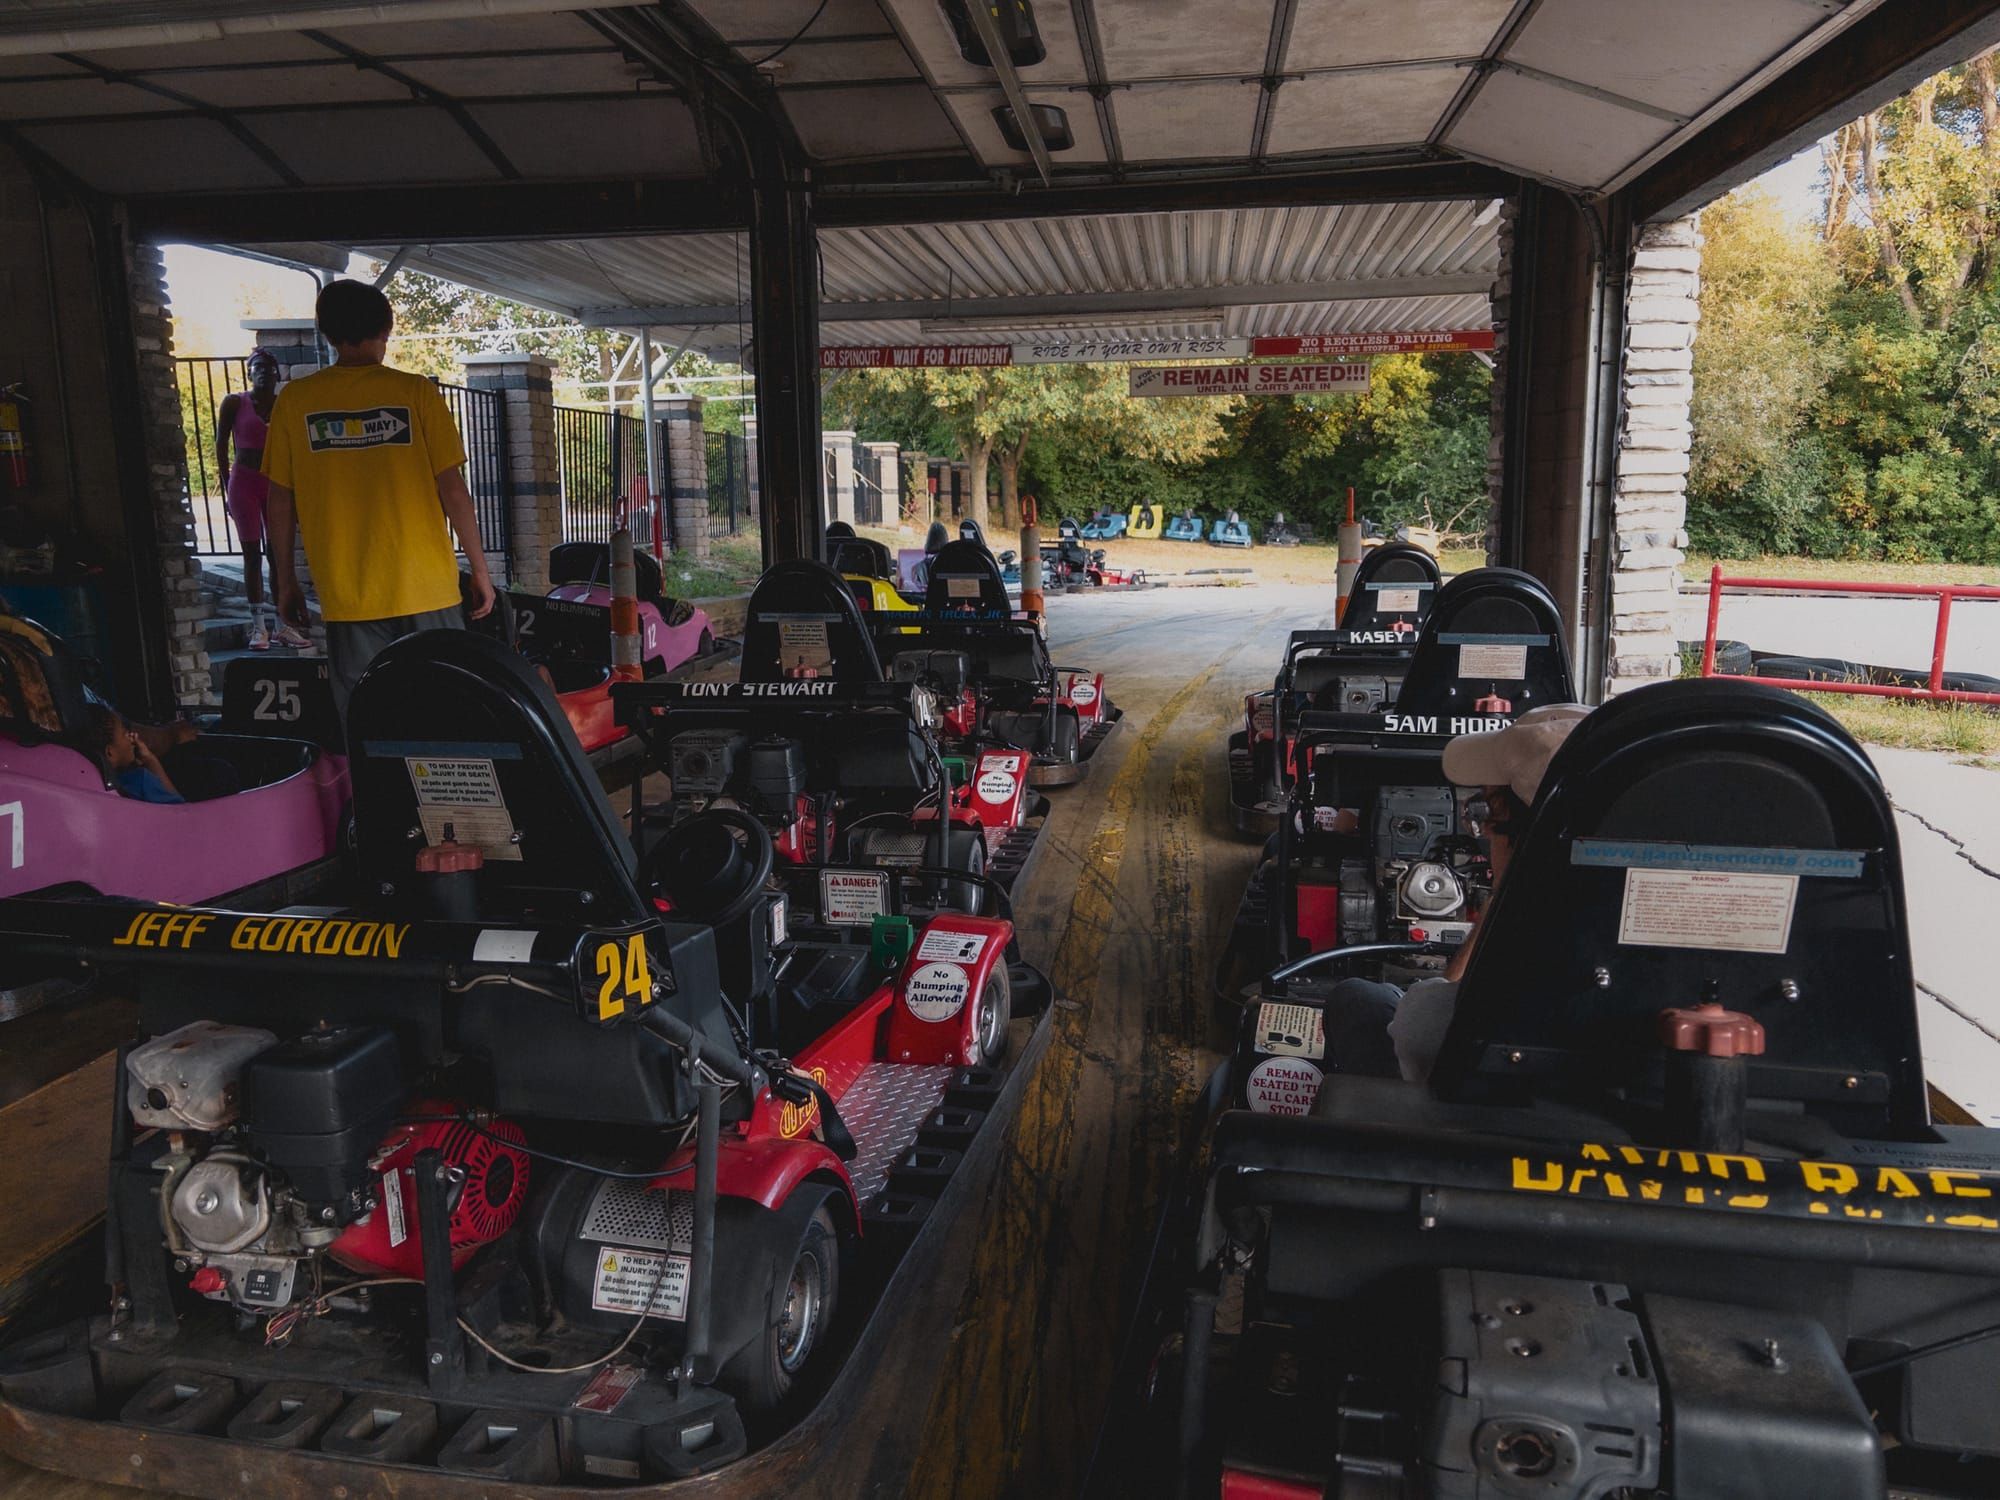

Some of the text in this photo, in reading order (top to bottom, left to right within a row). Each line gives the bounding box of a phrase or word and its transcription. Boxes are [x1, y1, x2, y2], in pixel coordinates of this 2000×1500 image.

[1302, 333, 1453, 347] NO RECKLESS DRIVING
[1032, 342, 1227, 359] RIDE AT YOUR OWN RISK
[1298, 346, 1320, 354] RIDE
[1363, 344, 1400, 352] STOPPED
[823, 352, 836, 366] OR
[838, 350, 880, 366] SPINOUT?
[893, 349, 920, 366] WAIT
[923, 348, 944, 365] FOR
[948, 347, 1010, 364] ATTENDENT
[1135, 372, 1162, 388] SAFETY
[1138, 370, 1153, 380] FOR
[1164, 366, 1366, 386] REMAIN SEATED!!!
[1197, 382, 1330, 393] UNTIL ALL CARTS ARE IN
[314, 419, 397, 441] FUN WAY!
[546, 602, 600, 617] NO BUMPING
[648, 624, 656, 650] 12
[1350, 631, 1409, 644] KASEY
[682, 682, 838, 696] TONY STEWART
[253, 680, 301, 721] 25
[1384, 714, 1438, 734] SAM
[842, 878, 878, 888] DANGER
[113, 912, 412, 958] JEFF GORDON
[595, 933, 654, 1021] 24
[934, 970, 949, 978] No
[913, 981, 964, 992] Bumping
[910, 993, 962, 1003] Allowed!
[1266, 1068, 1313, 1081] REMAIN
[1252, 1078, 1298, 1092] SEATED
[1258, 1091, 1280, 1101] ALL
[622, 1256, 686, 1270] TO HELP PRVENT
[620, 1266, 647, 1275] INJURY
[612, 1277, 626, 1285] pads
[600, 1286, 629, 1295] maintained
[630, 1289, 640, 1297] and
[664, 1293, 680, 1303] during
